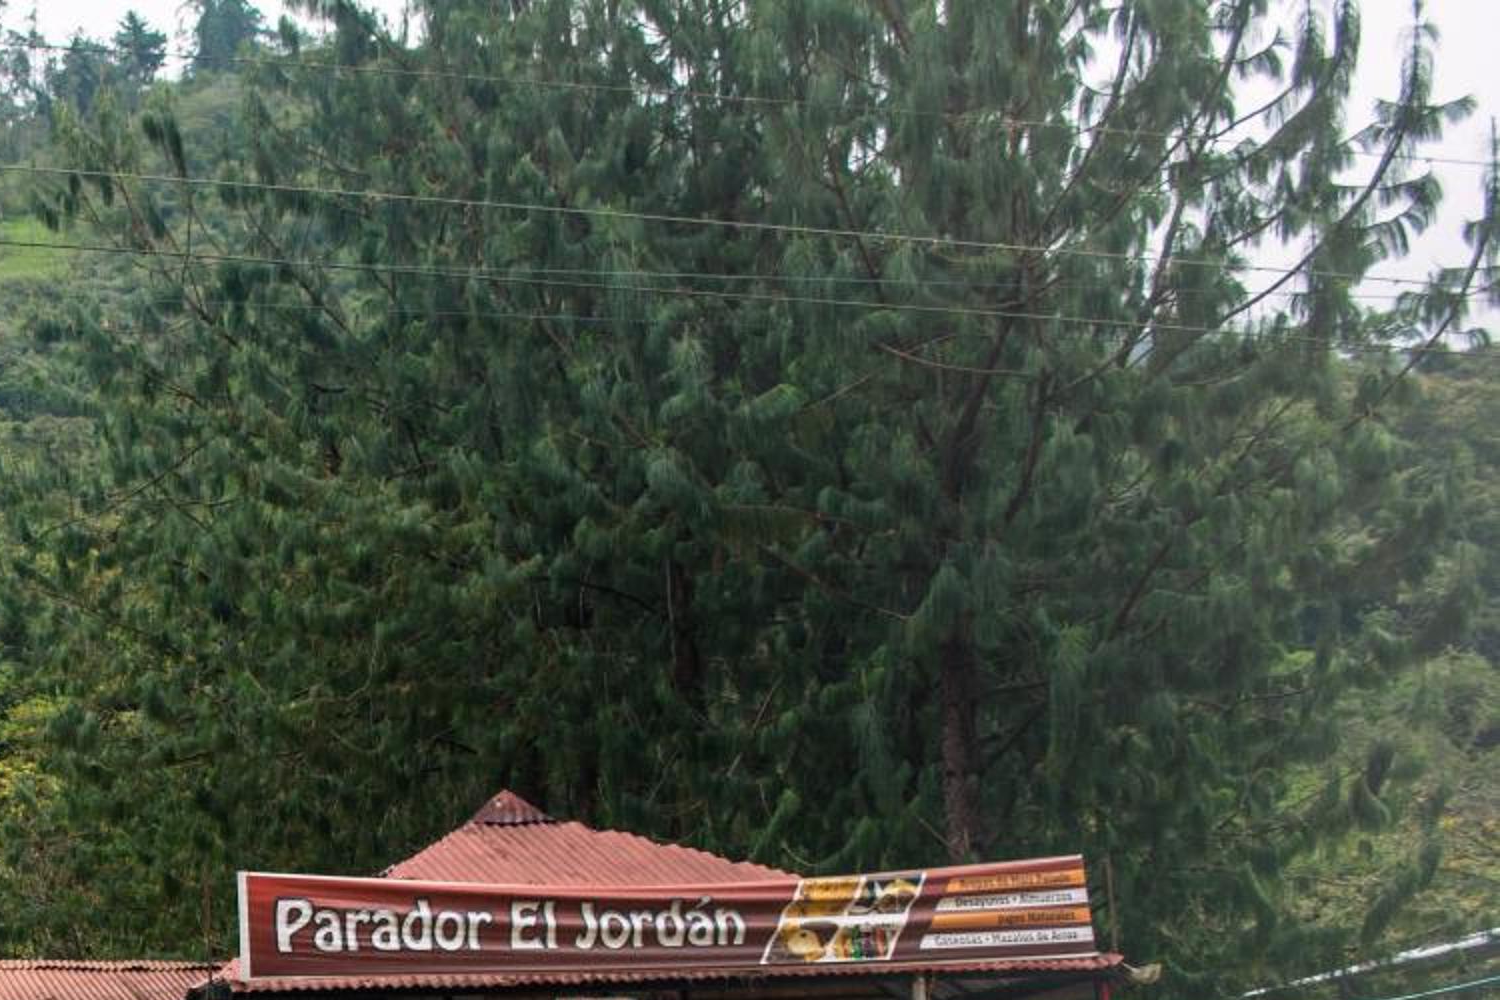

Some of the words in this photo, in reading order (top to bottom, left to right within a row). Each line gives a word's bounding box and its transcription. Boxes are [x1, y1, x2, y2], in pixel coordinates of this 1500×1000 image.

[276, 897, 493, 953] Parador
[510, 900, 558, 950] El
[575, 895, 746, 950] Jordán
